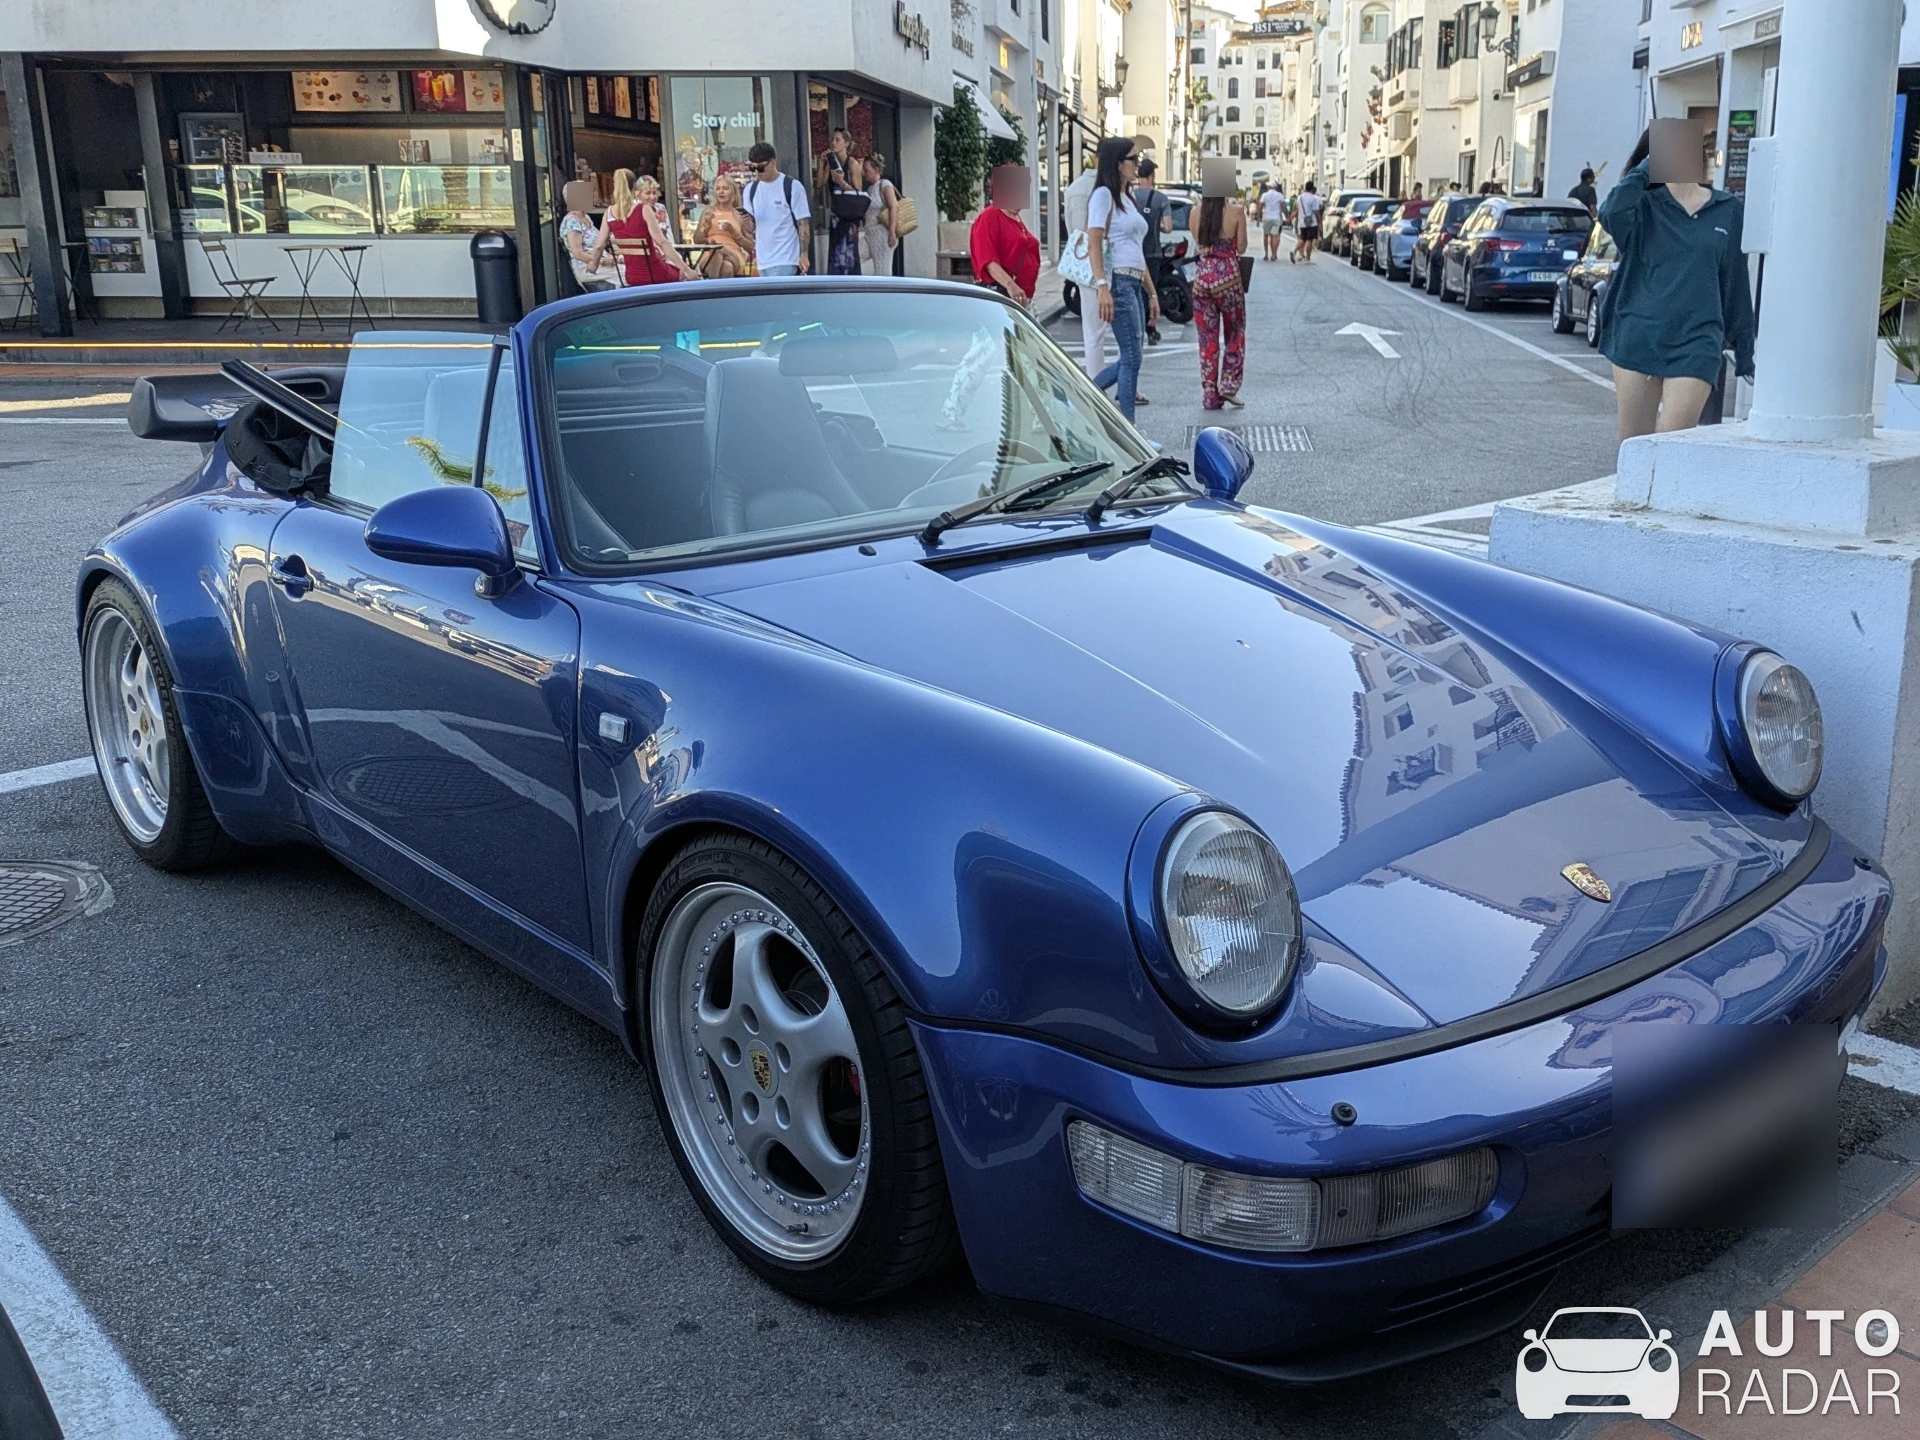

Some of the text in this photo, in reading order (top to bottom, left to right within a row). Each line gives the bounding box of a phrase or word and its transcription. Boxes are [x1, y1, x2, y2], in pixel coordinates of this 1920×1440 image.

[692, 111, 761, 129] Stay chill
[1136, 115, 1161, 127] IOR
